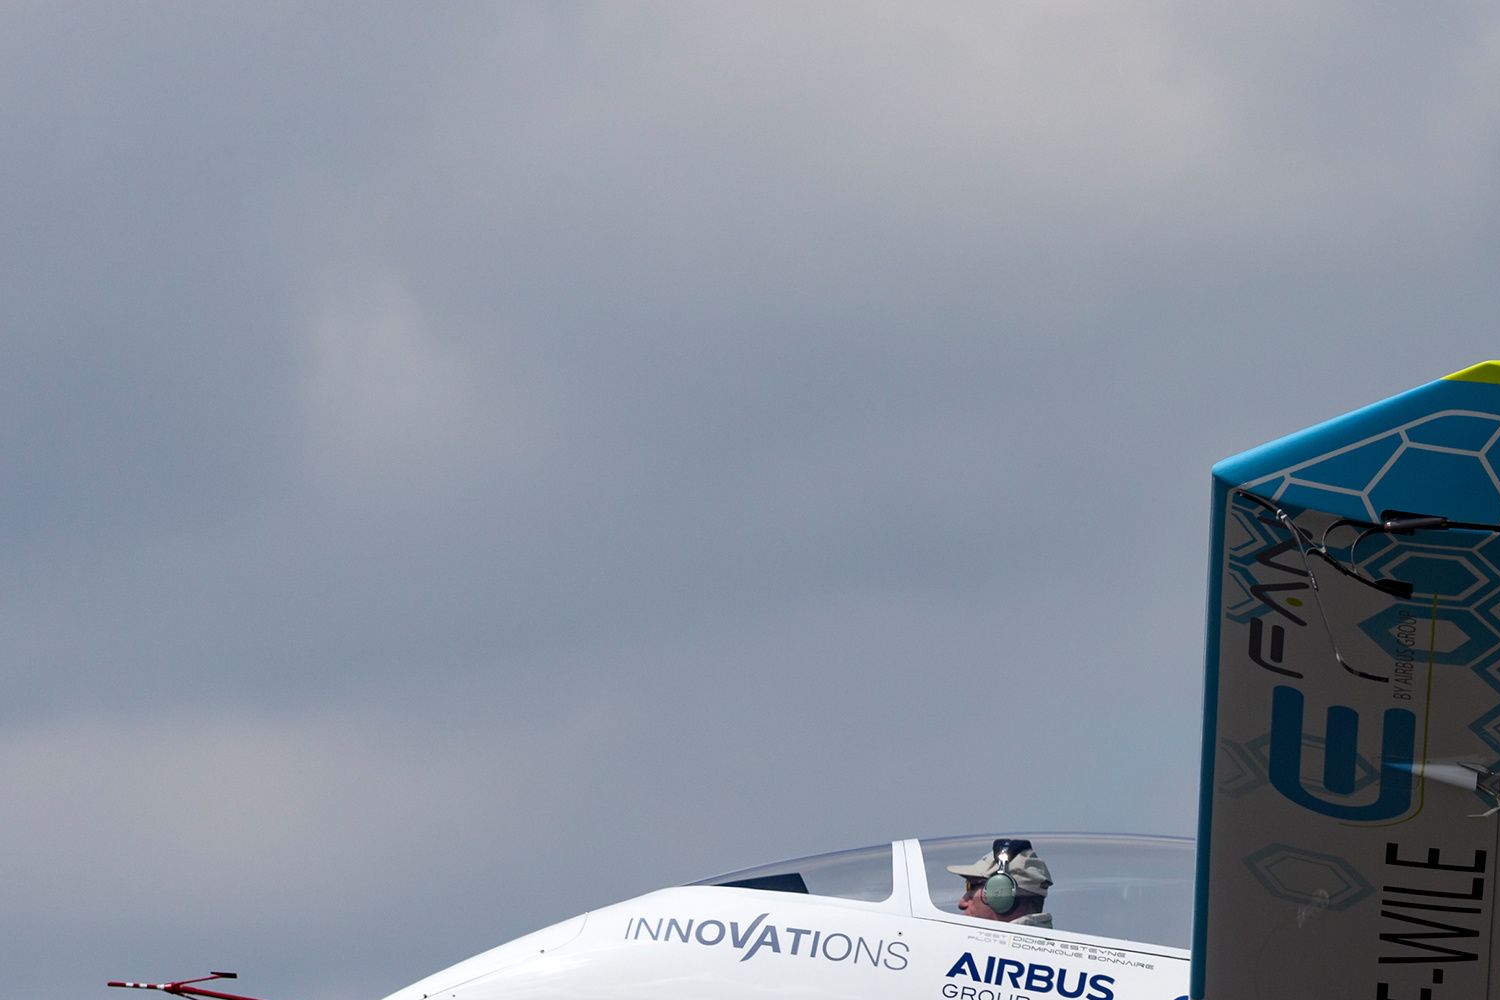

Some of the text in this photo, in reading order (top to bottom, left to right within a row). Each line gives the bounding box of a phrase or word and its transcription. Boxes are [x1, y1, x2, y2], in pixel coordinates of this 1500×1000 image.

[1392, 609, 1417, 701] BY AIRBUS GROUP
[624, 912, 911, 971] INNOVATIONS
[967, 935, 1155, 971] PILOTS DOMINIQUE BONNAIRE
[977, 931, 1127, 959] TEST DIDIER ESTEYNE
